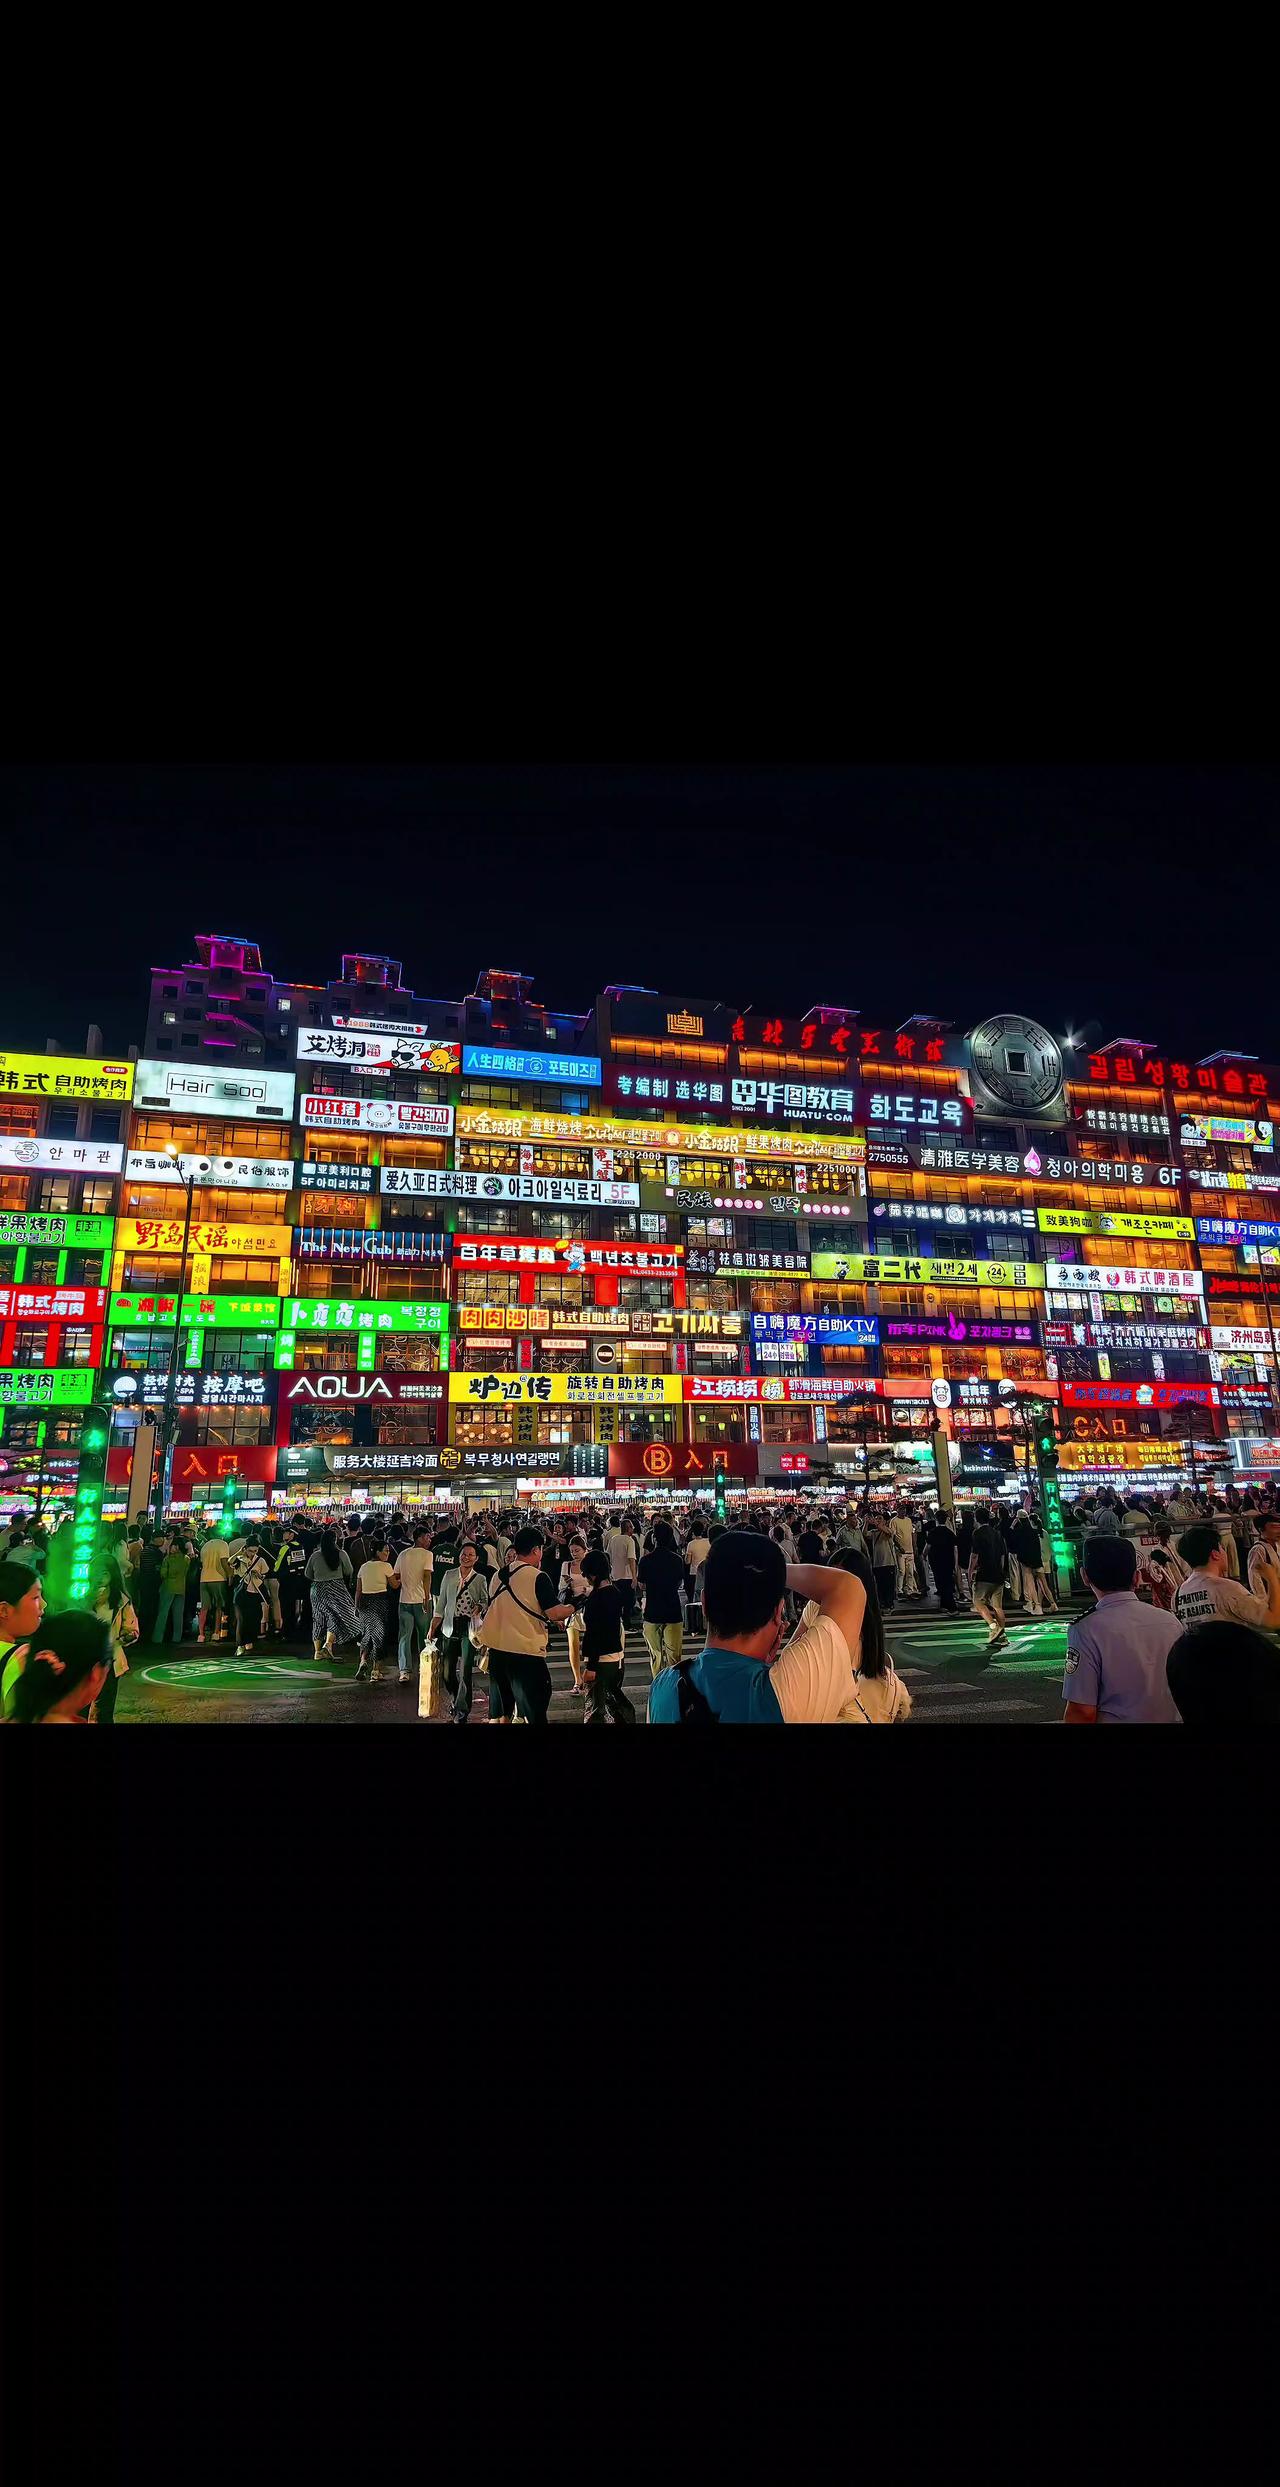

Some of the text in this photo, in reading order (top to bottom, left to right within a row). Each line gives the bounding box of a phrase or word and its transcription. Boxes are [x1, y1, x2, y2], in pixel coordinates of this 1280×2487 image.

[467, 1052, 517, 1072] 人生四格
[55, 1075, 127, 1091] 自助烤肉
[170, 1078, 214, 1094] Hair
[617, 1075, 723, 1103] 考编制 选华图
[757, 1082, 853, 1113] 华图教育
[308, 1101, 357, 1117] 小红猪
[400, 1106, 447, 1124] 빨간돼지
[870, 1094, 963, 1127] 화도교육
[305, 1115, 361, 1127] 韩式自助烤肉
[461, 1111, 522, 1137] 小金姑娘
[530, 1117, 582, 1136] 海鲜烧烤
[685, 1129, 739, 1153] 小金姑娘
[746, 1133, 792, 1152] 鲜果烤肉
[521, 1149, 534, 1173] 海鲜
[617, 1150, 661, 1160] 2252000
[868, 1152, 909, 1165] 2750555
[920, 1148, 1020, 1173] 清雅医学美容
[238, 1164, 290, 1177] 民俗服饰
[317, 1164, 372, 1179] 亚美利口腔
[817, 1163, 857, 1174] 2251000
[1046, 1158, 1145, 1185] 청아의학미용
[1159, 1167, 1182, 1186] 6F
[301, 1177, 371, 1191] 5F 아미리치과
[386, 1170, 477, 1196] 爱久亚日式料理
[508, 1178, 602, 1202] 아크아일식료리
[610, 1184, 630, 1199] 5F
[1121, 1217, 1174, 1235] 개조은카페
[136, 1221, 229, 1252] 野岛民谣
[231, 1238, 278, 1251] 야섬민요
[301, 1241, 328, 1252] The
[333, 1242, 362, 1253] New
[460, 1243, 556, 1264] 百年草烤肉
[590, 1249, 679, 1268] 백년초불고기
[863, 1259, 921, 1280] 富二代
[991, 1267, 1002, 1276] 24
[1124, 1270, 1194, 1287] 韩式啤酒屋
[18, 1294, 53, 1308] 韩式
[51, 1302, 85, 1315] 烤肉
[401, 1306, 441, 1317] 복정정
[552, 1310, 629, 1324] 韩式自助烤肉
[416, 1318, 441, 1329] 구이
[1231, 1330, 1280, 1345] 济州岛韩
[203, 1375, 266, 1394] 按摩吧
[288, 1376, 393, 1398] AQUA
[469, 1375, 552, 1401] 炉边传
[567, 1375, 665, 1391] 旋转自助烤肉
[691, 1377, 758, 1398] 江捞捞
[788, 1379, 876, 1392] 虾滑海鲜自助火锅
[518, 1405, 532, 1442] 韩式烤肉
[600, 1405, 614, 1442] 韩式烤肉
[750, 1406, 760, 1440] 自助火锅
[182, 1453, 239, 1476] 入口
[333, 1455, 438, 1469] 服务大楼延吉冷面
[463, 1452, 560, 1467] 복무청사연길랭면
